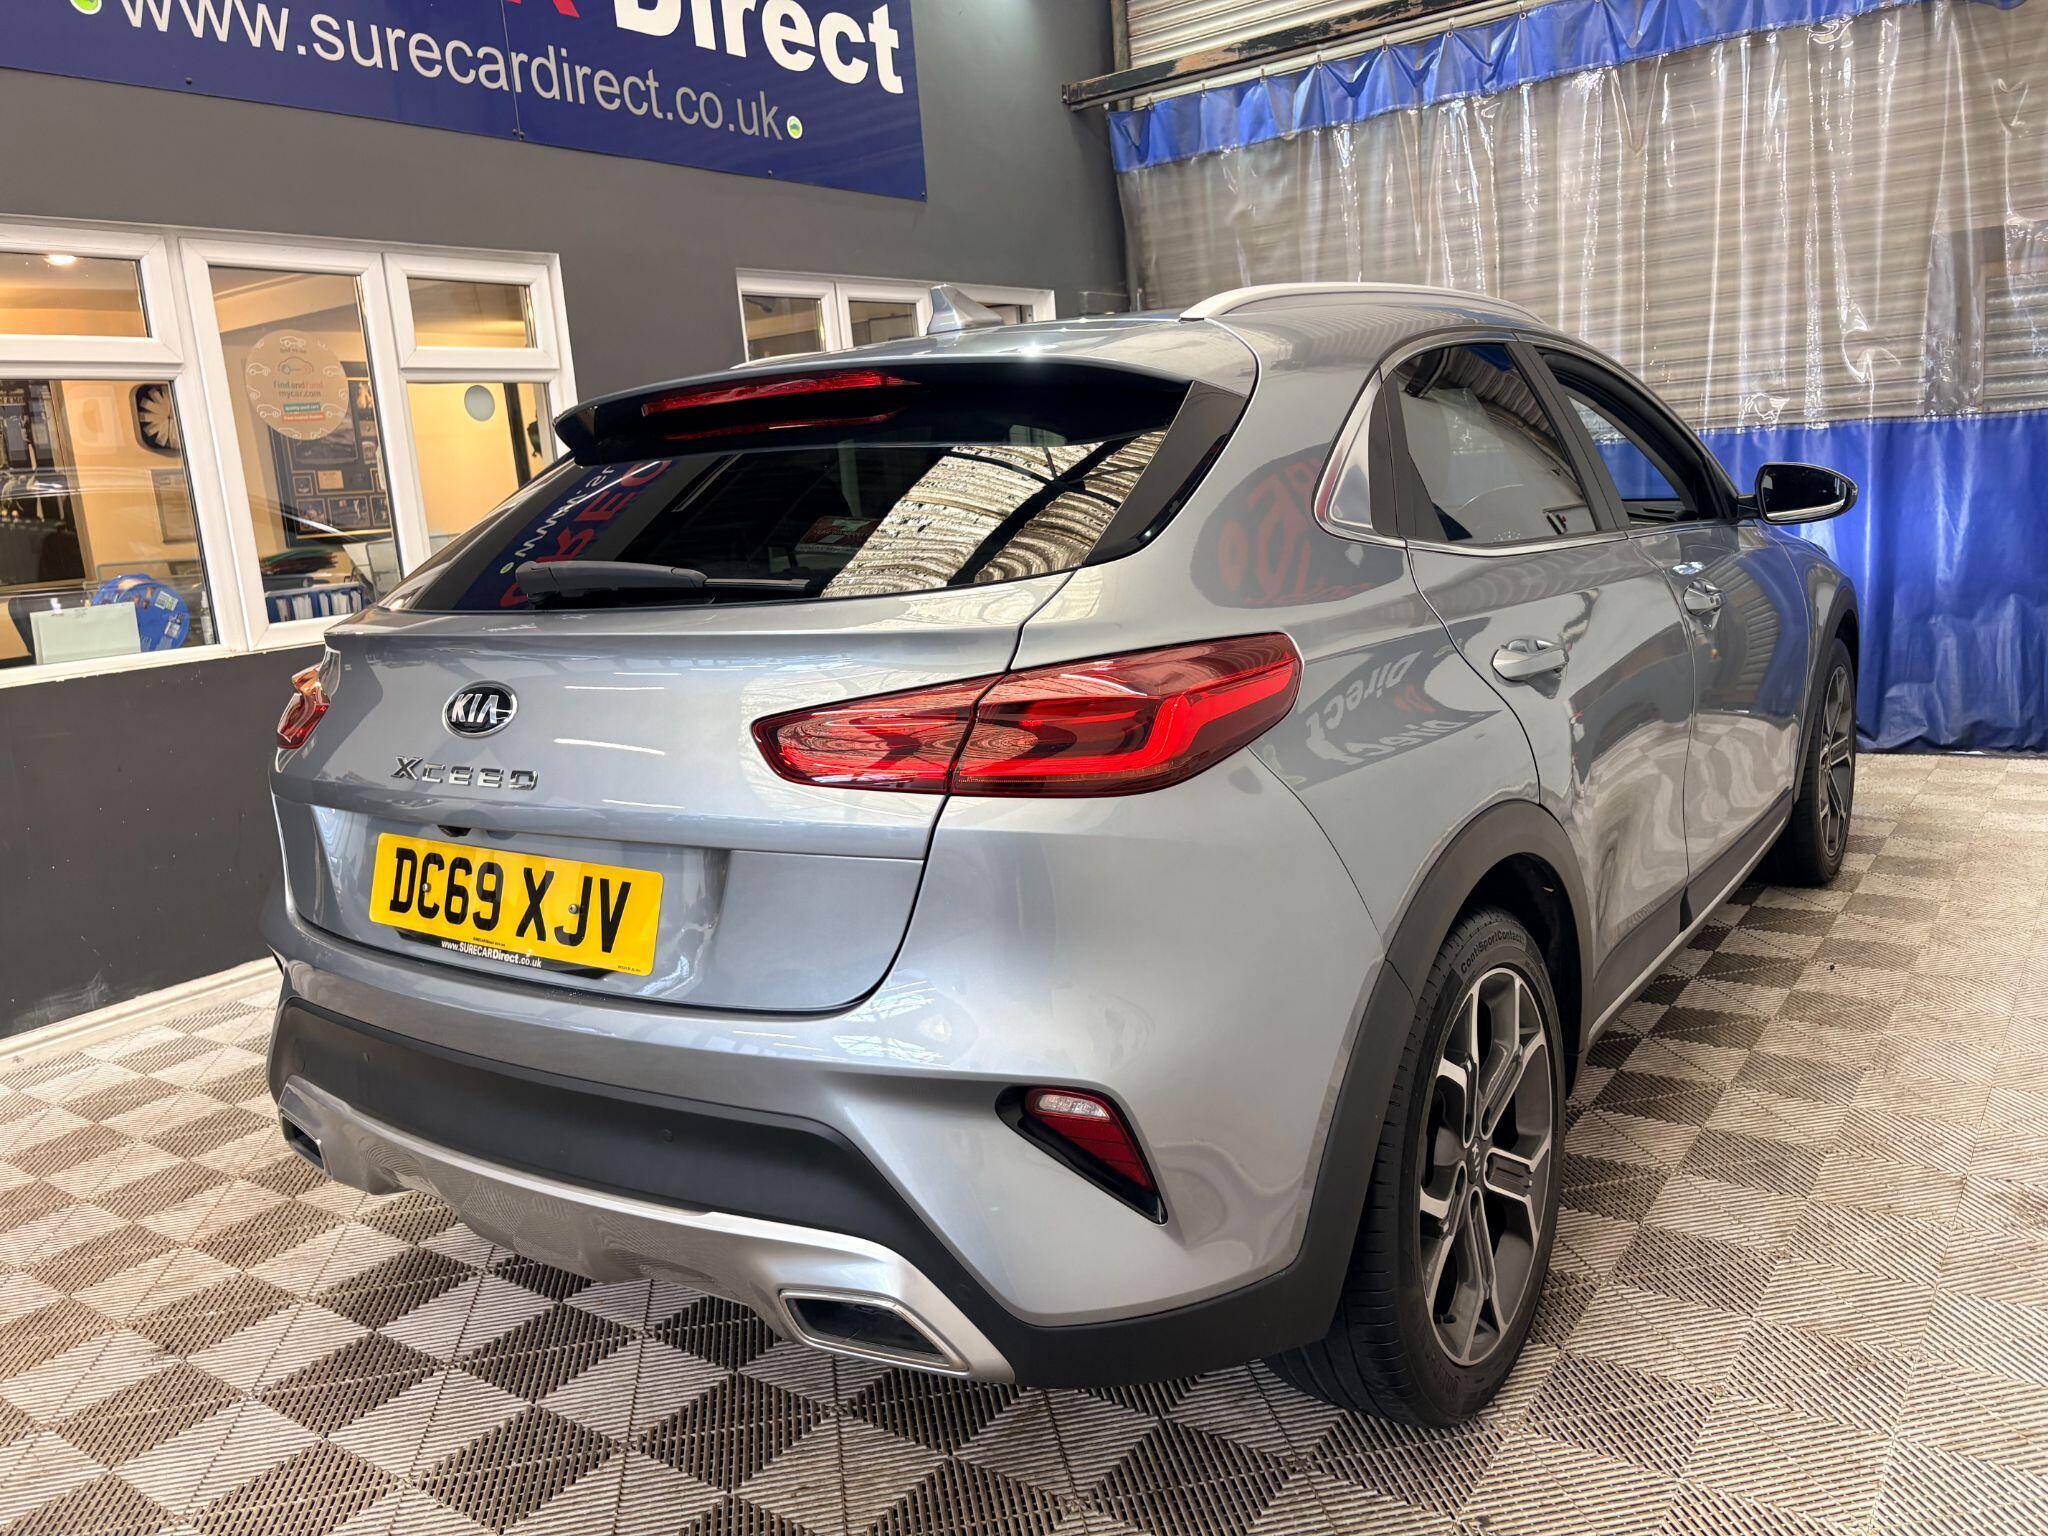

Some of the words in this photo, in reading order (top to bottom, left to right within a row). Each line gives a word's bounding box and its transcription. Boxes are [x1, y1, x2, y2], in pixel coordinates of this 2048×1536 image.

[121, 0, 783, 140] www.surecardirect.co.uk
[615, 0, 904, 94] Direct
[450, 693, 511, 725] KIA
[389, 847, 505, 932] DC69
[516, 867, 632, 954] XJV
[441, 940, 543, 968] www.SURECARDirect.co.uk
